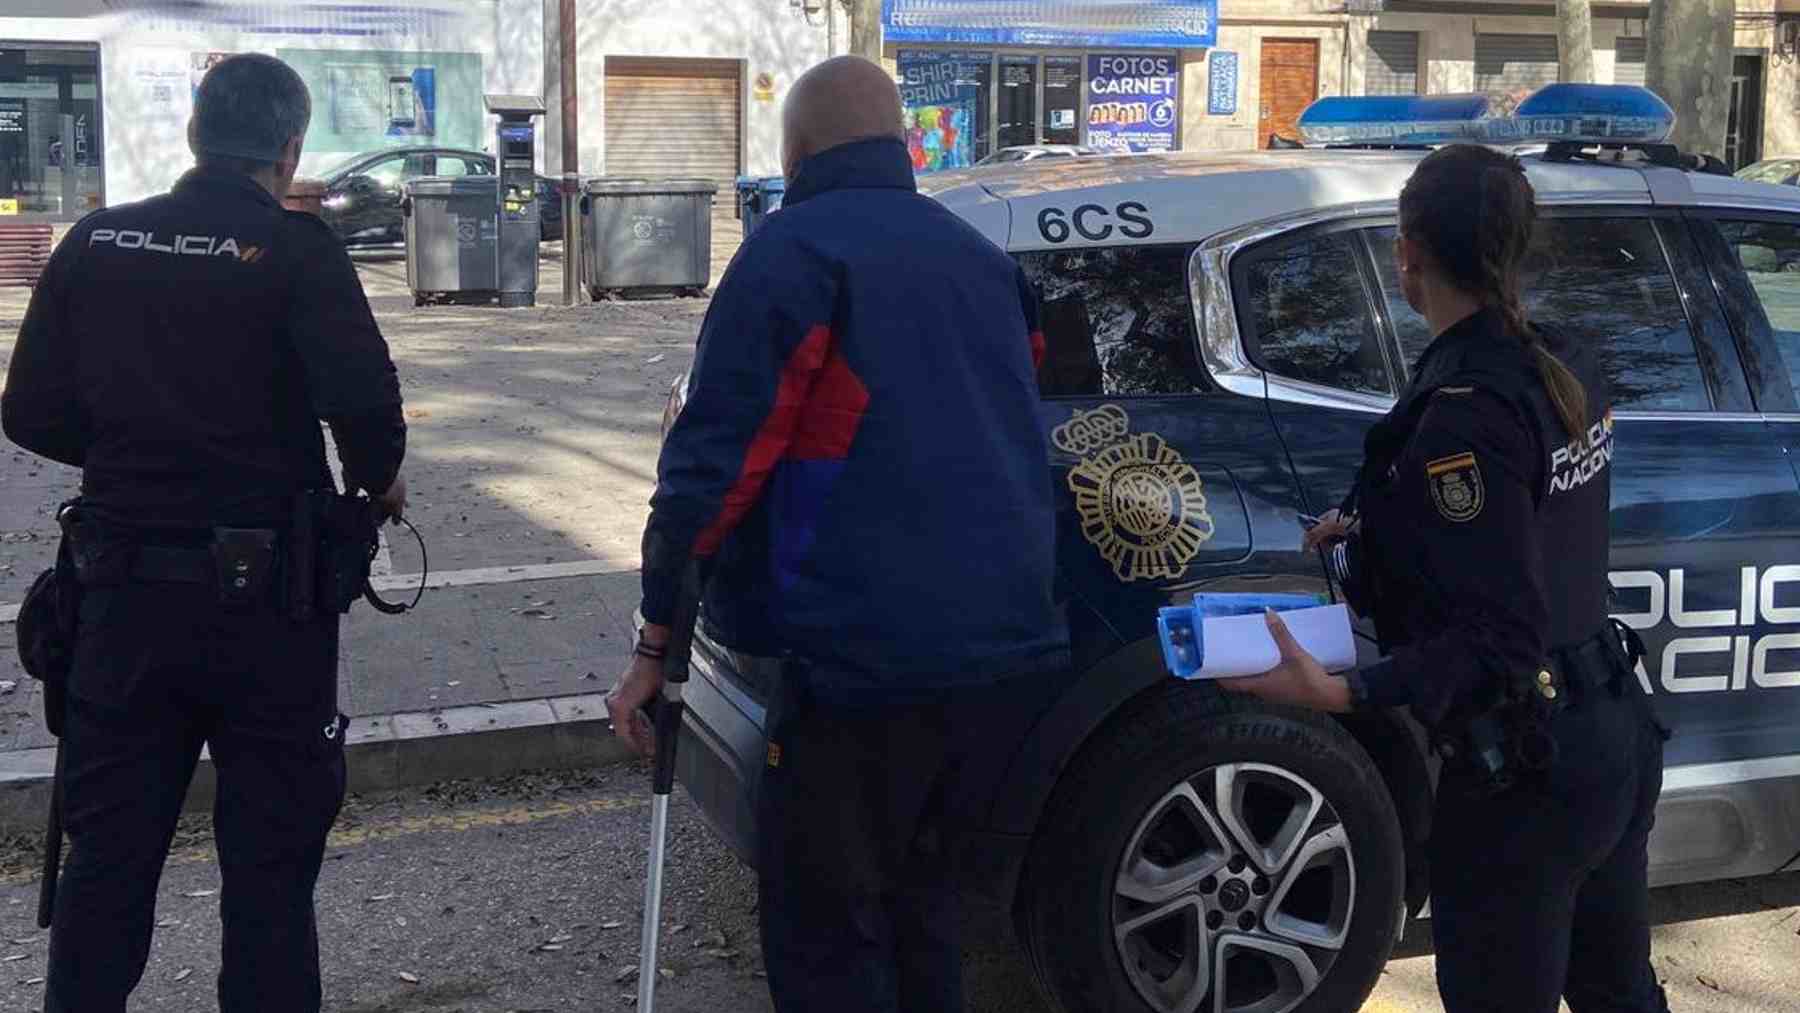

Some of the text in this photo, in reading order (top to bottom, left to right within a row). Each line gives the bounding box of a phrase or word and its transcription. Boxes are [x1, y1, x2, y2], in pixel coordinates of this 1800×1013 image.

[1100, 57, 1168, 76] FOTOS
[1091, 76, 1174, 94] CARNET
[1037, 201, 1154, 243] 6CS
[89, 229, 241, 257] POLICIA
